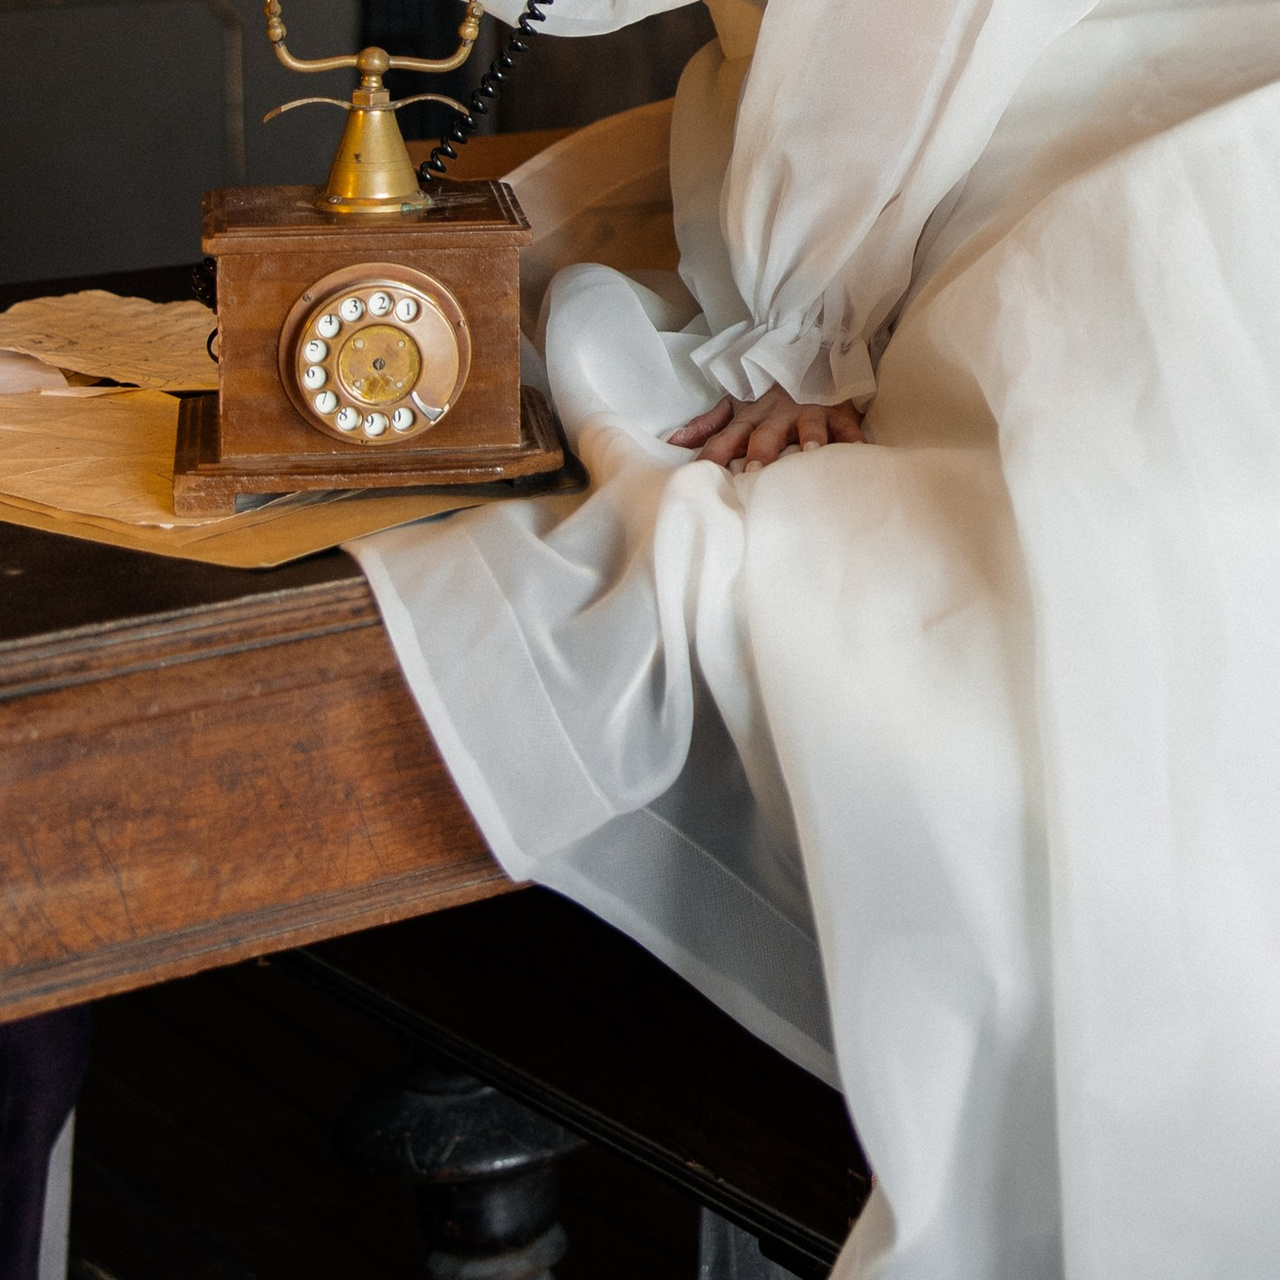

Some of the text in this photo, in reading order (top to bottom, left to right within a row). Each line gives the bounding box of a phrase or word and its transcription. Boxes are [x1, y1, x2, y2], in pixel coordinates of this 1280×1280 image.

[350, 300, 358, 313] 3
[378, 297, 386, 310] 2
[406, 303, 411, 316] 1
[325, 314, 333, 325] 4
[310, 341, 319, 352] 5
[306, 368, 315, 378] 6
[320, 391, 328, 404] 7
[339, 408, 347, 420] 8
[366, 414, 374, 427] 9
[393, 409, 401, 423] 0
